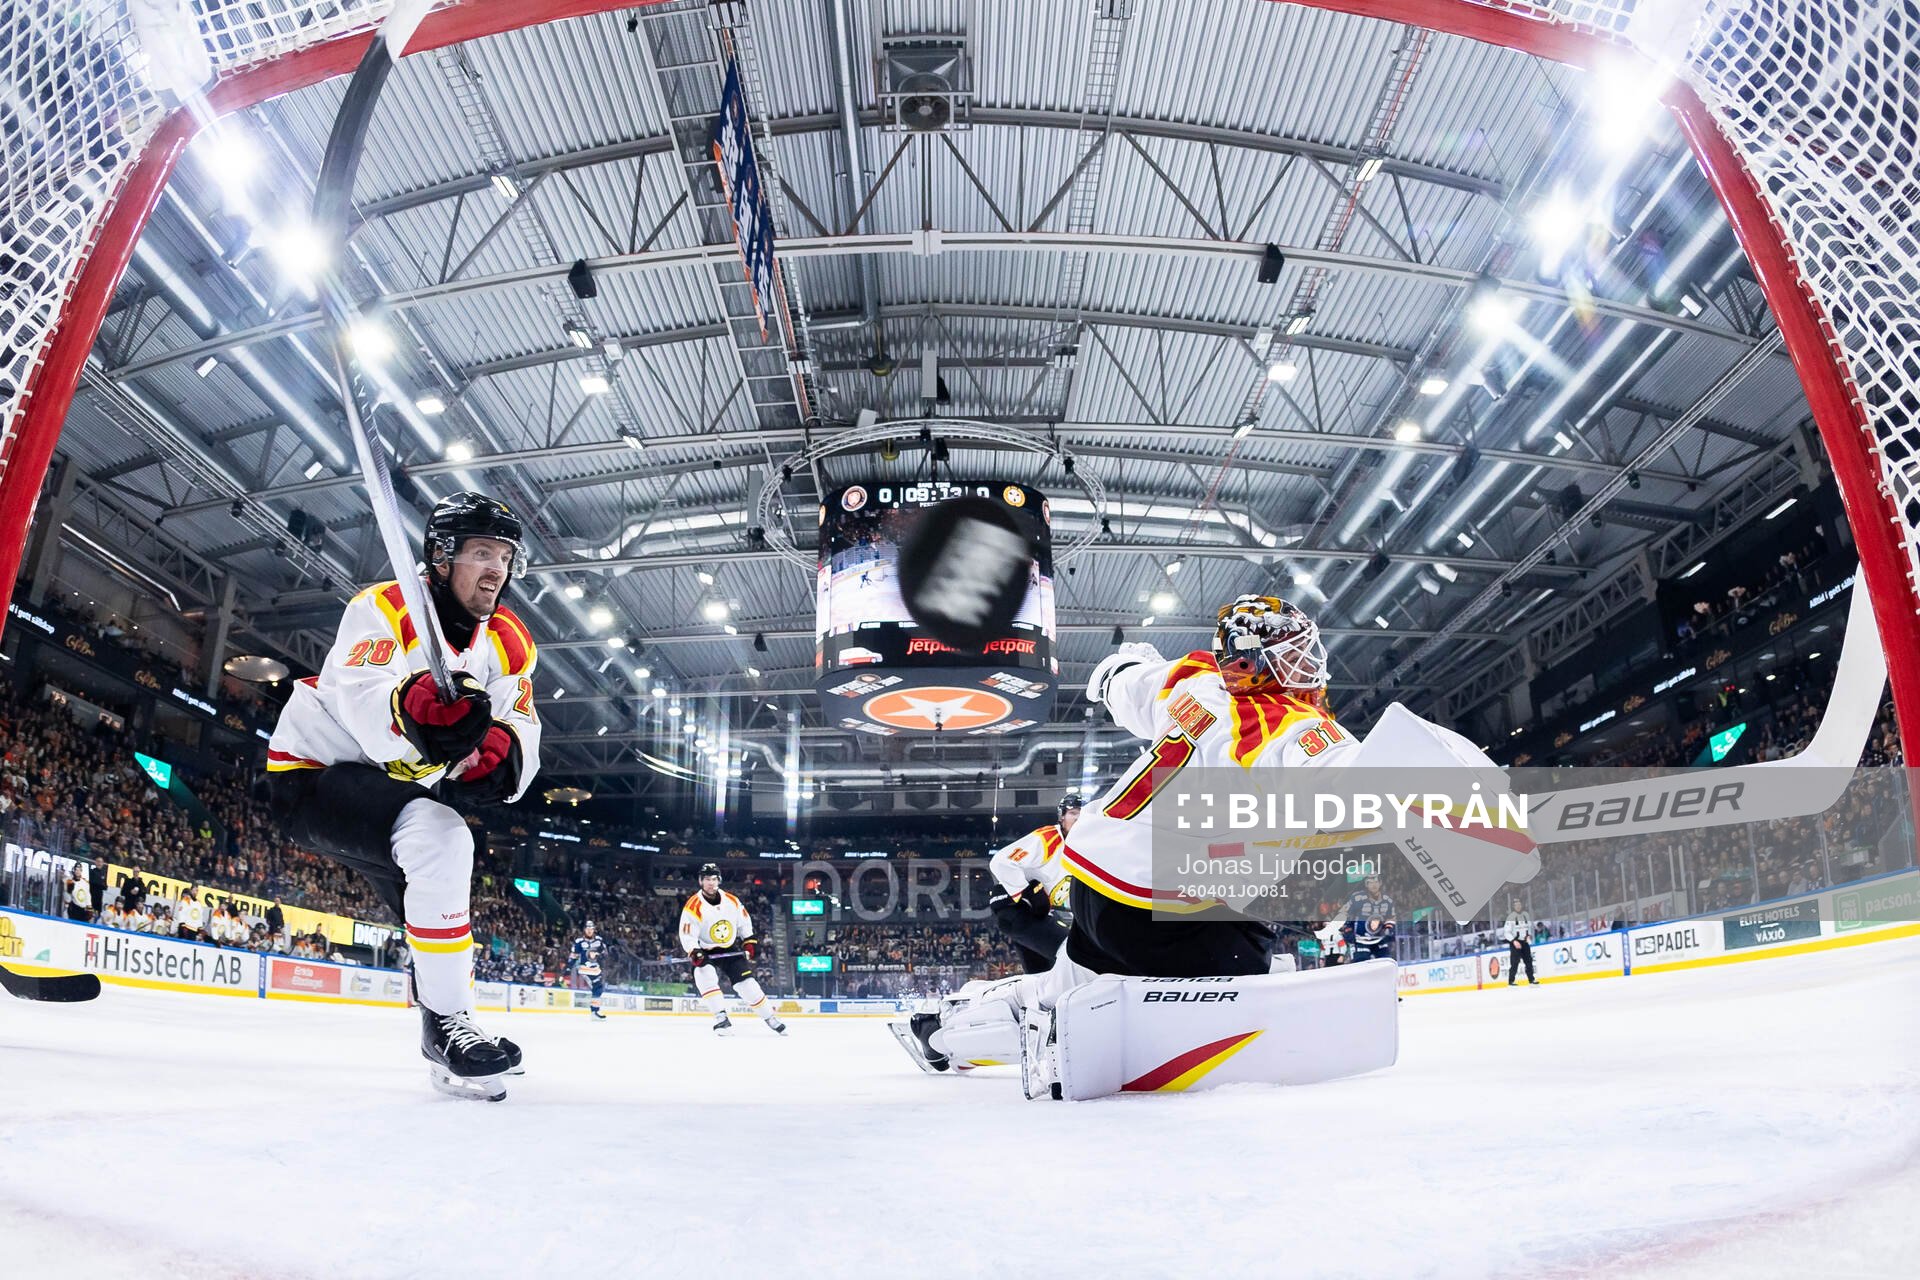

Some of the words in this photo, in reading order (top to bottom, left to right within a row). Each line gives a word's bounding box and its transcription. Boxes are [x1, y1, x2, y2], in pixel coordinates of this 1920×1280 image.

[879, 488, 892, 503] 0
[344, 638, 397, 666] 28
[982, 638, 1036, 654] jetpak
[513, 677, 539, 725] 2
[1298, 719, 1346, 757] 31
[1557, 782, 1744, 831] BAUER
[1405, 836, 1468, 908] BAUER
[1739, 912, 1763, 927] ELITE
[1764, 906, 1800, 922] HOTELS
[1657, 928, 1700, 953] PADEL
[103, 936, 204, 982] Hisstech
[212, 954, 242, 984] AB
[1143, 991, 1239, 1002] BAUER
